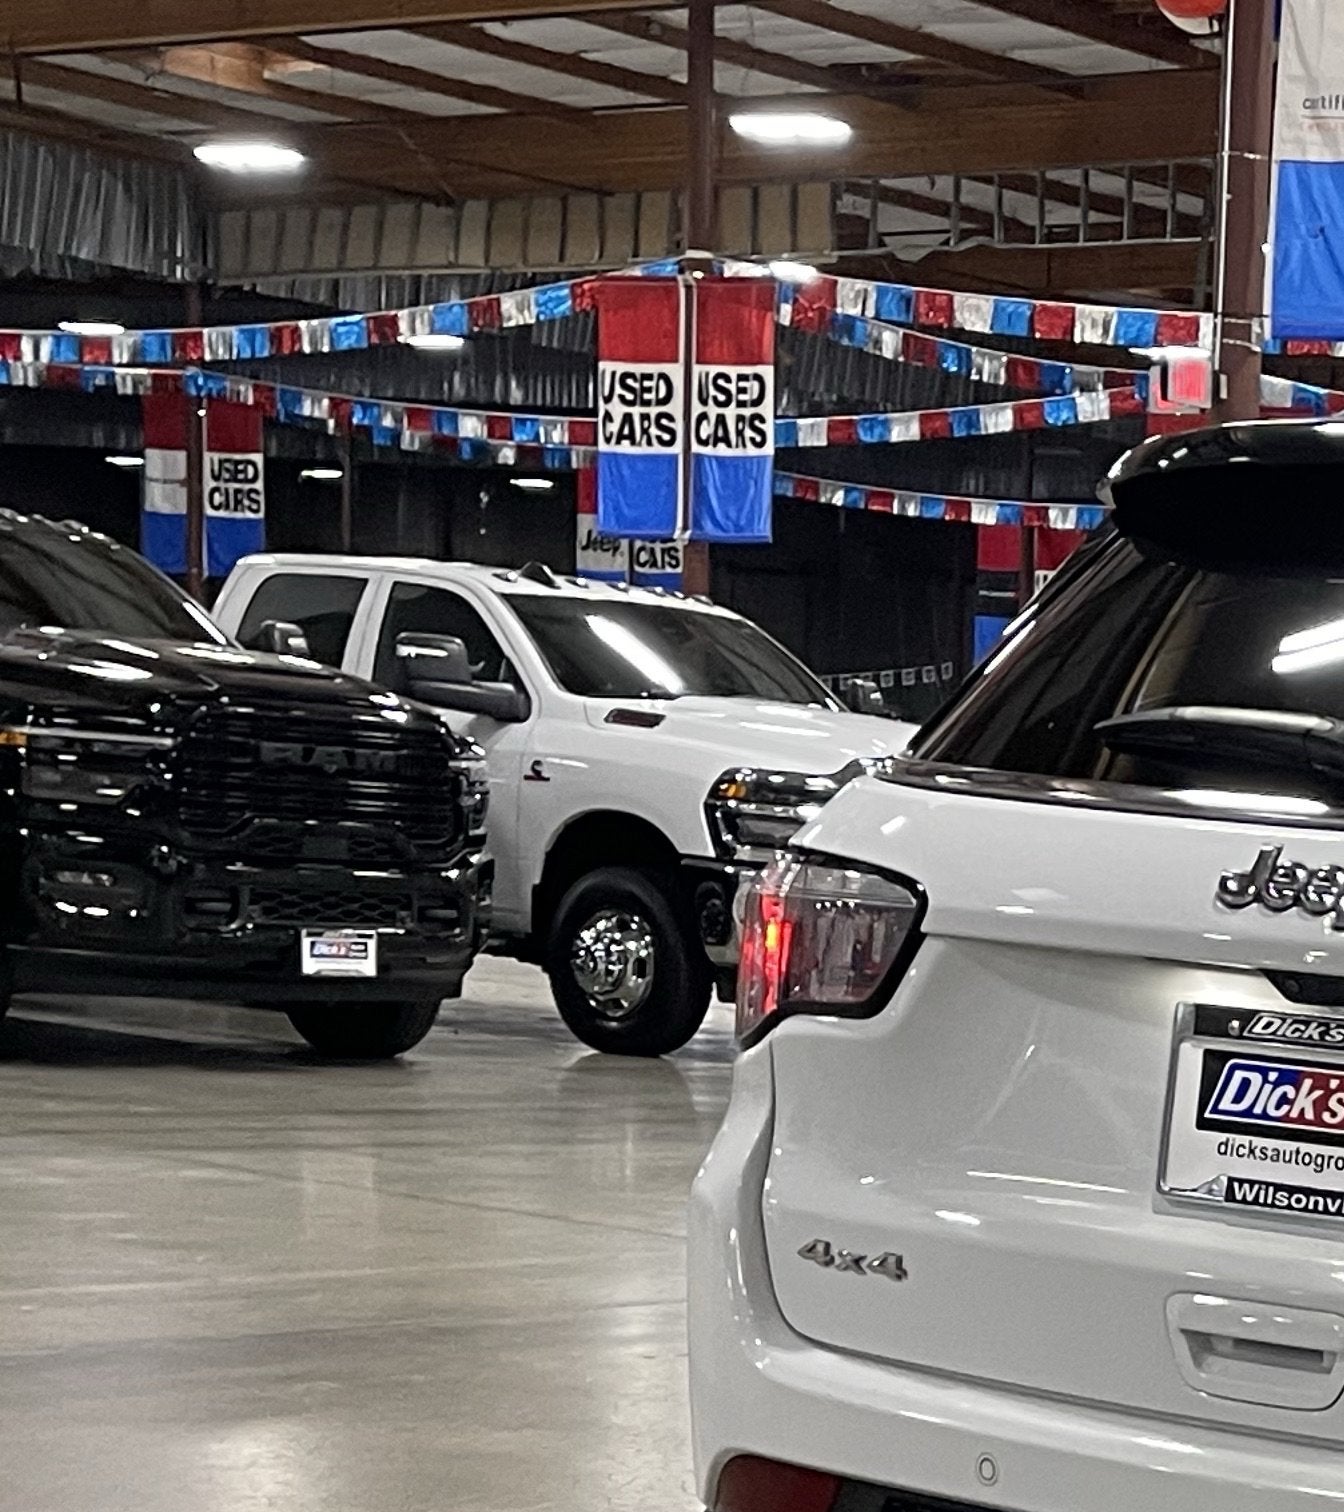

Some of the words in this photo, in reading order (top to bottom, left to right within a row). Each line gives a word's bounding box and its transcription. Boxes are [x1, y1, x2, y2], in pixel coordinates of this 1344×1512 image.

[601, 368, 674, 407] USED
[698, 371, 767, 408] USED
[602, 409, 677, 447] CARS
[695, 411, 767, 449] CARS
[209, 456, 260, 484] USED
